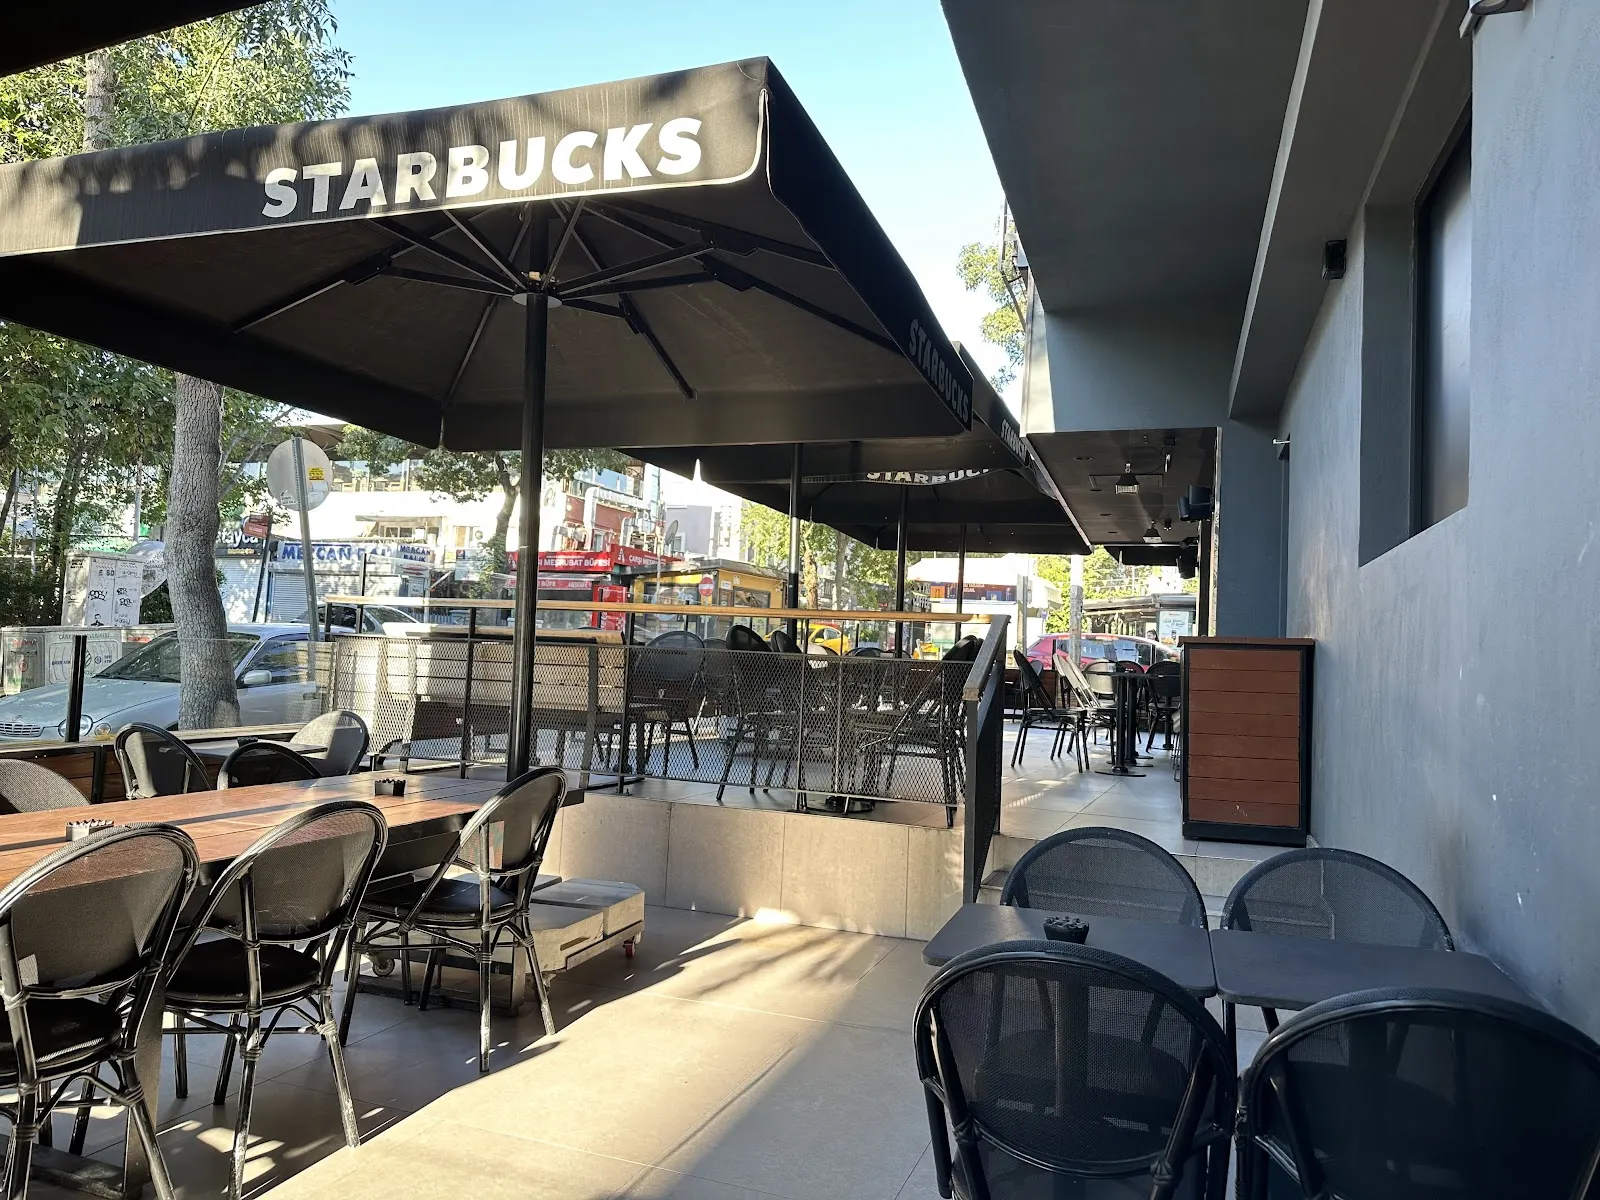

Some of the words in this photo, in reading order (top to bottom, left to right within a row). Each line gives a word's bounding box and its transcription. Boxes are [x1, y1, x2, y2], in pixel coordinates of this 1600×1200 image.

[261, 117, 702, 218] STARBUCKS
[909, 318, 969, 423] STARBUCKS
[282, 545, 351, 561] MECAN
